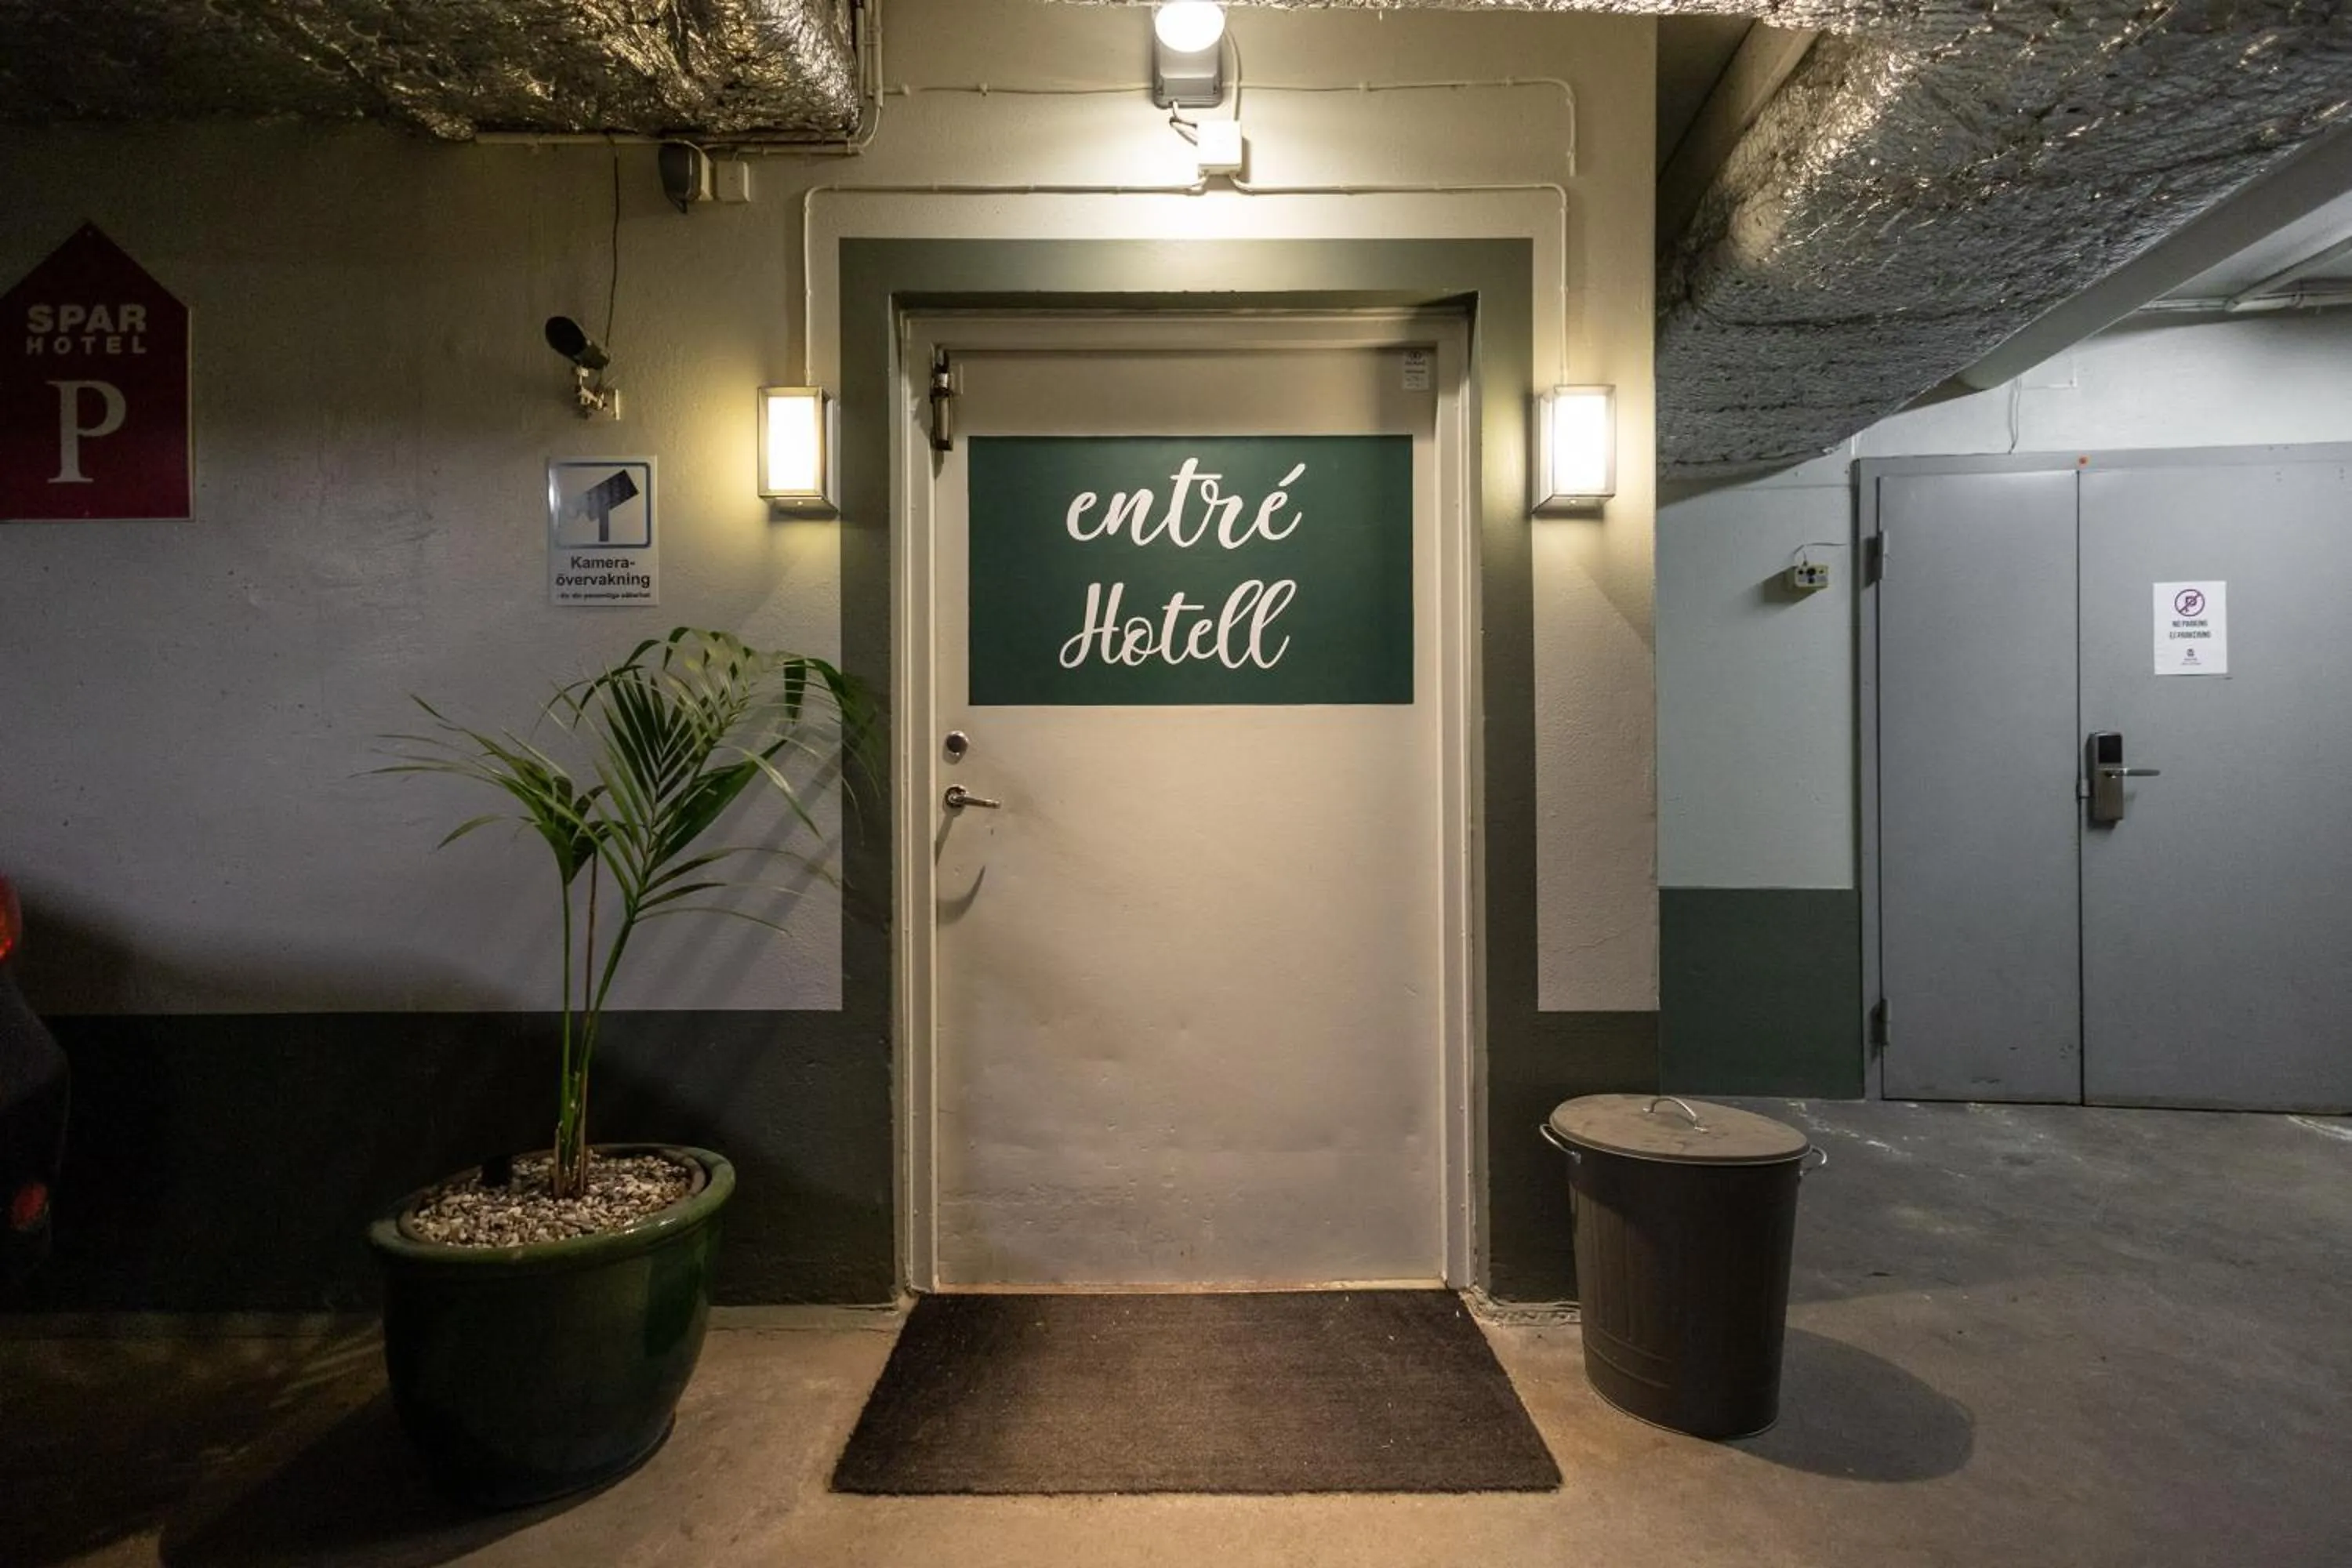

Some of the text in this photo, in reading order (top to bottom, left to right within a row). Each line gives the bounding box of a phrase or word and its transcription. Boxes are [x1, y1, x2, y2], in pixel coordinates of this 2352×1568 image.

[27, 303, 147, 333] SPAR
[26, 336, 147, 355] HOTEL
[45, 379, 127, 483] P
[1066, 457, 1306, 550] entré
[571, 556, 636, 569] Kamera-
[556, 572, 651, 589] övervakning
[1059, 579, 1298, 669] Hotell
